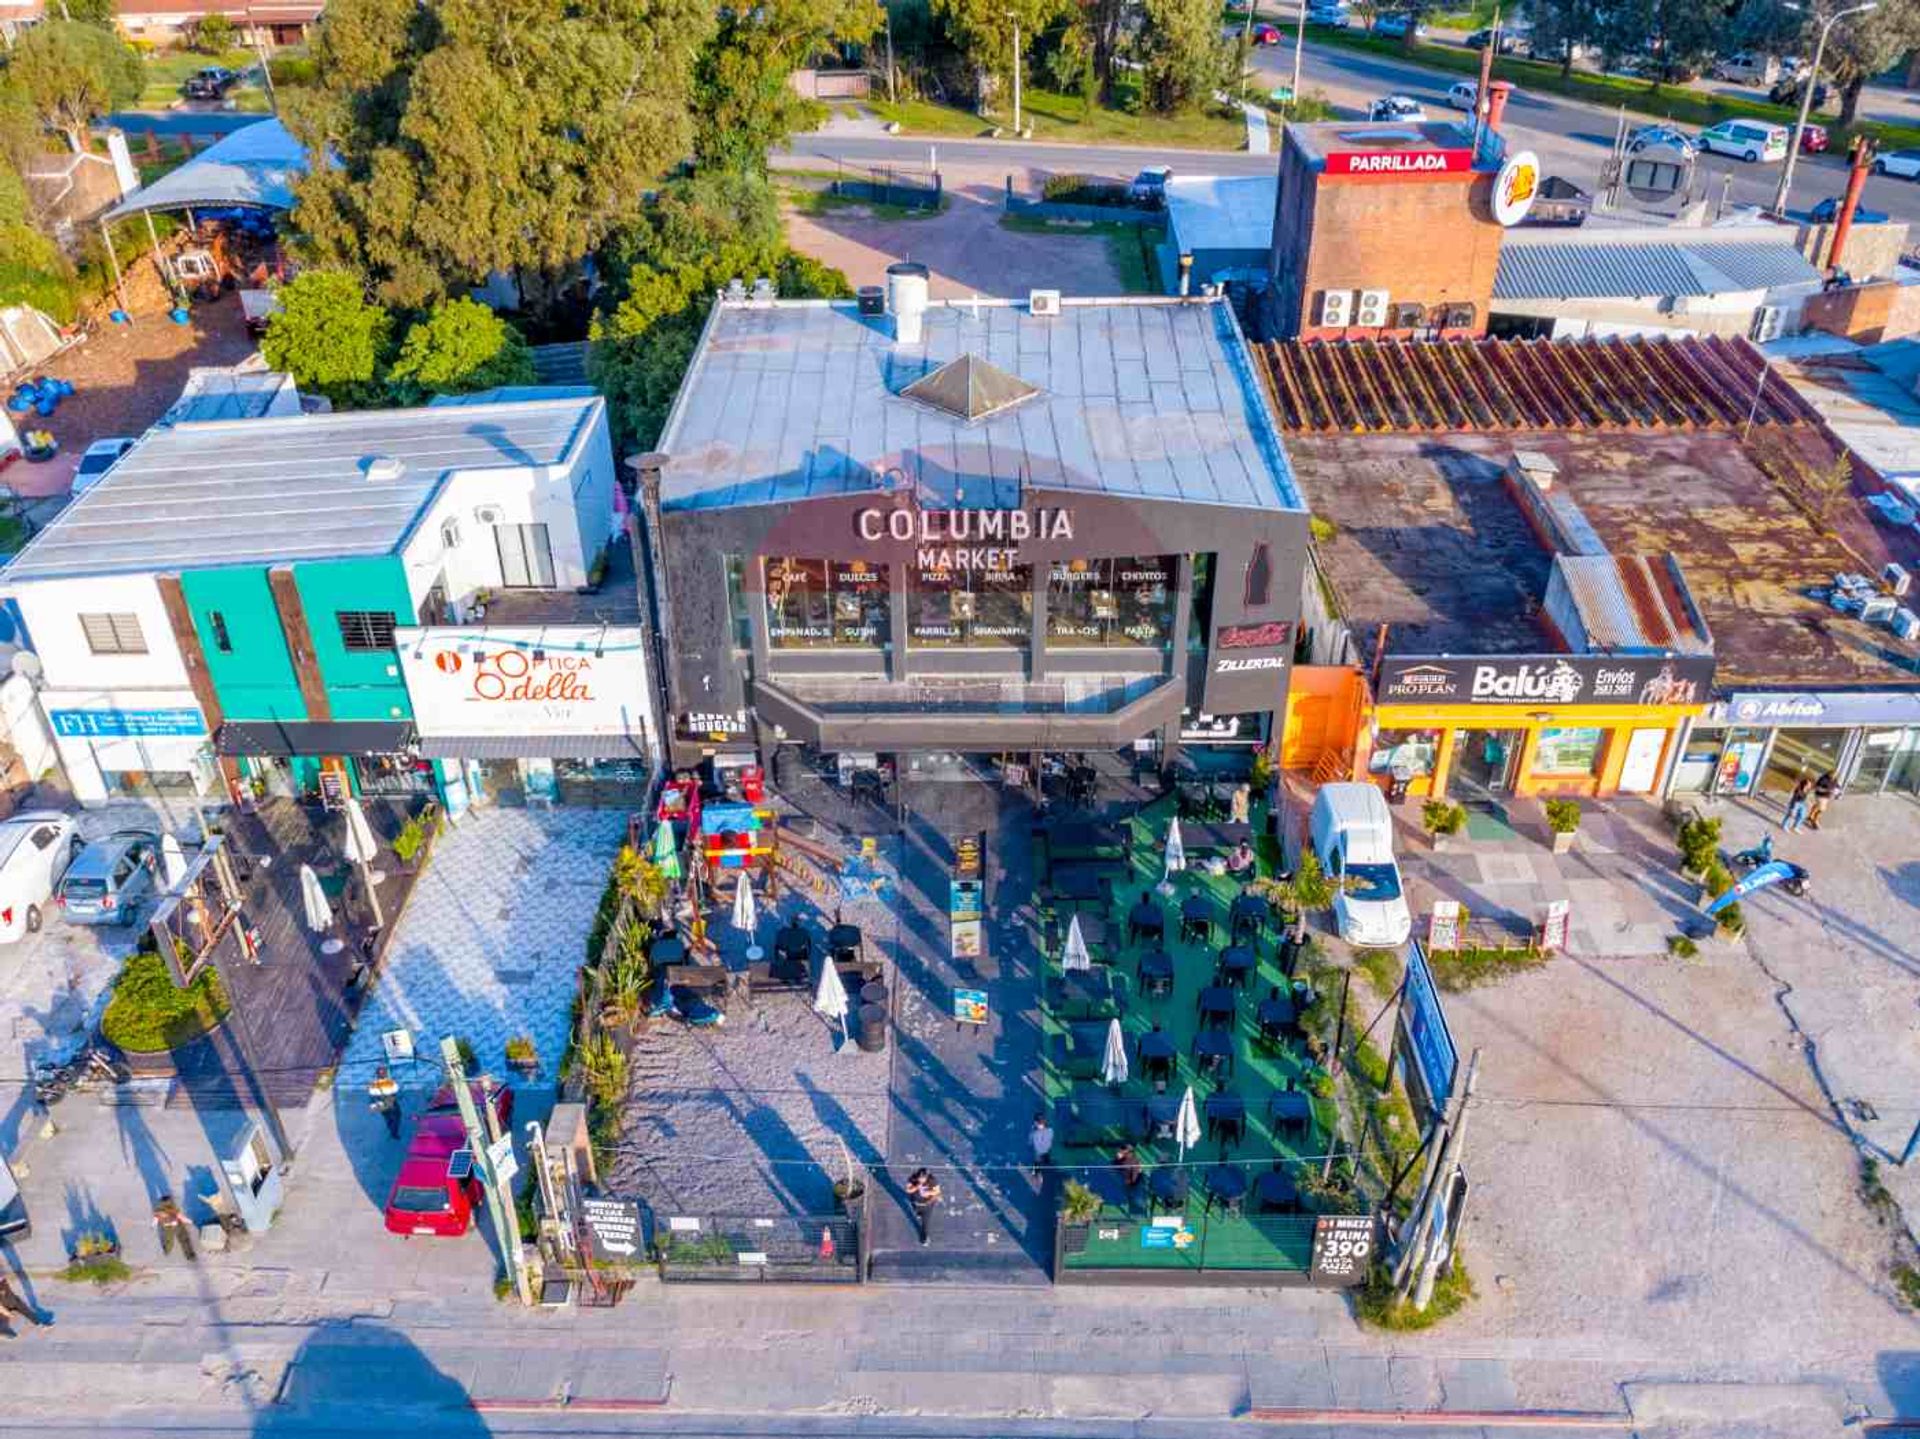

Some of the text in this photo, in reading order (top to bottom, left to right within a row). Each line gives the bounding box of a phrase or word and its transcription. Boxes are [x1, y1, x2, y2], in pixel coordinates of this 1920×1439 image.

[1349, 154, 1448, 171] PARRILLADA
[859, 508, 1074, 541] COLUMBIA
[917, 548, 1019, 571] MARKET
[838, 572, 879, 582] DULCES
[921, 572, 950, 582] PIZZA
[914, 626, 960, 637] PARRILLA
[1216, 658, 1285, 673] ZILLERTAL
[1472, 664, 1547, 697] Balú
[1596, 667, 1636, 684] Envíos
[1419, 684, 1457, 694] PLAN
